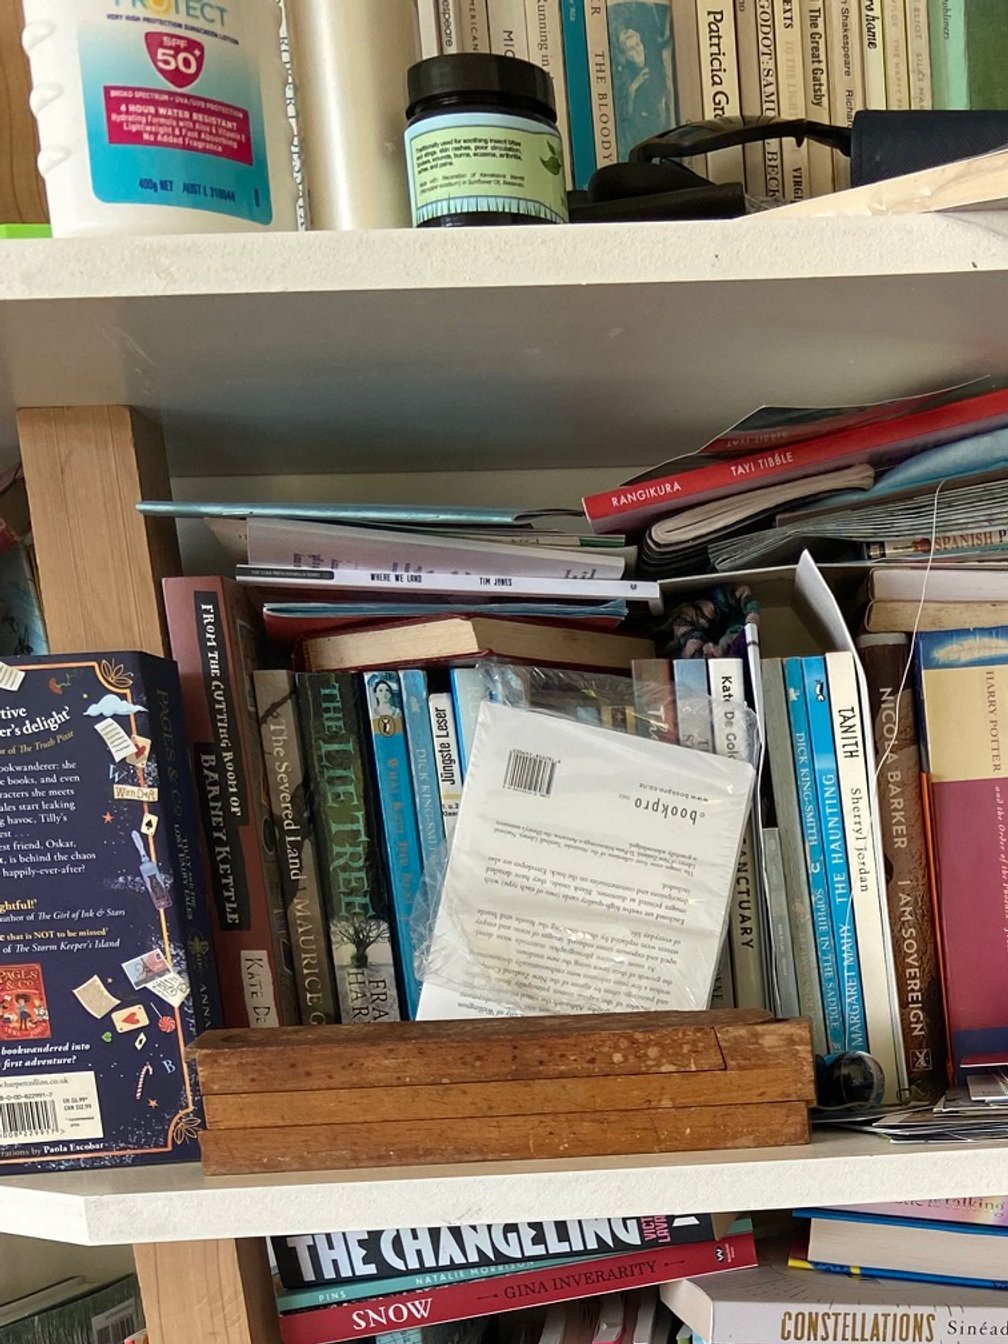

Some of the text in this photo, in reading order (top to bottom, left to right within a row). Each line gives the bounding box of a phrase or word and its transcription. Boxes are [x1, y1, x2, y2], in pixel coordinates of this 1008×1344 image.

[162, 36, 188, 49] SPF
[707, 10, 729, 86] Patricia
[810, 30, 823, 107] Great Gatsby
[841, 8, 851, 77] Shakespeare
[159, 106, 237, 130] WATER RESISTANT
[598, 93, 612, 162] BLOODY
[611, 480, 682, 508] RANGIKURA
[730, 458, 756, 477] TAYI
[758, 451, 795, 471] TIBBLE
[934, 530, 995, 551] SPANISH
[436, 706, 457, 786] Jüngste Leser
[838, 706, 860, 760] TANITH
[985, 671, 1002, 773] HARRY POTTER
[41, 801, 76, 811] leaking
[201, 754, 240, 924] BARNEY KETTLE
[319, 739, 374, 918] LIE TREE
[634, 796, 698, 825] bookpro
[822, 774, 843, 870] HAUNTING
[887, 768, 908, 850] BARKER
[18, 852, 96, 863] behind chaos
[45, 840, 76, 849] Oskar,
[899, 925, 927, 1038] SOVEREIGN
[380, 1216, 642, 1271] CHANGELING
[352, 1261, 657, 1330] SNOW GINA INVERARITY
[781, 1312, 936, 1342] CONSTELLATIONS
